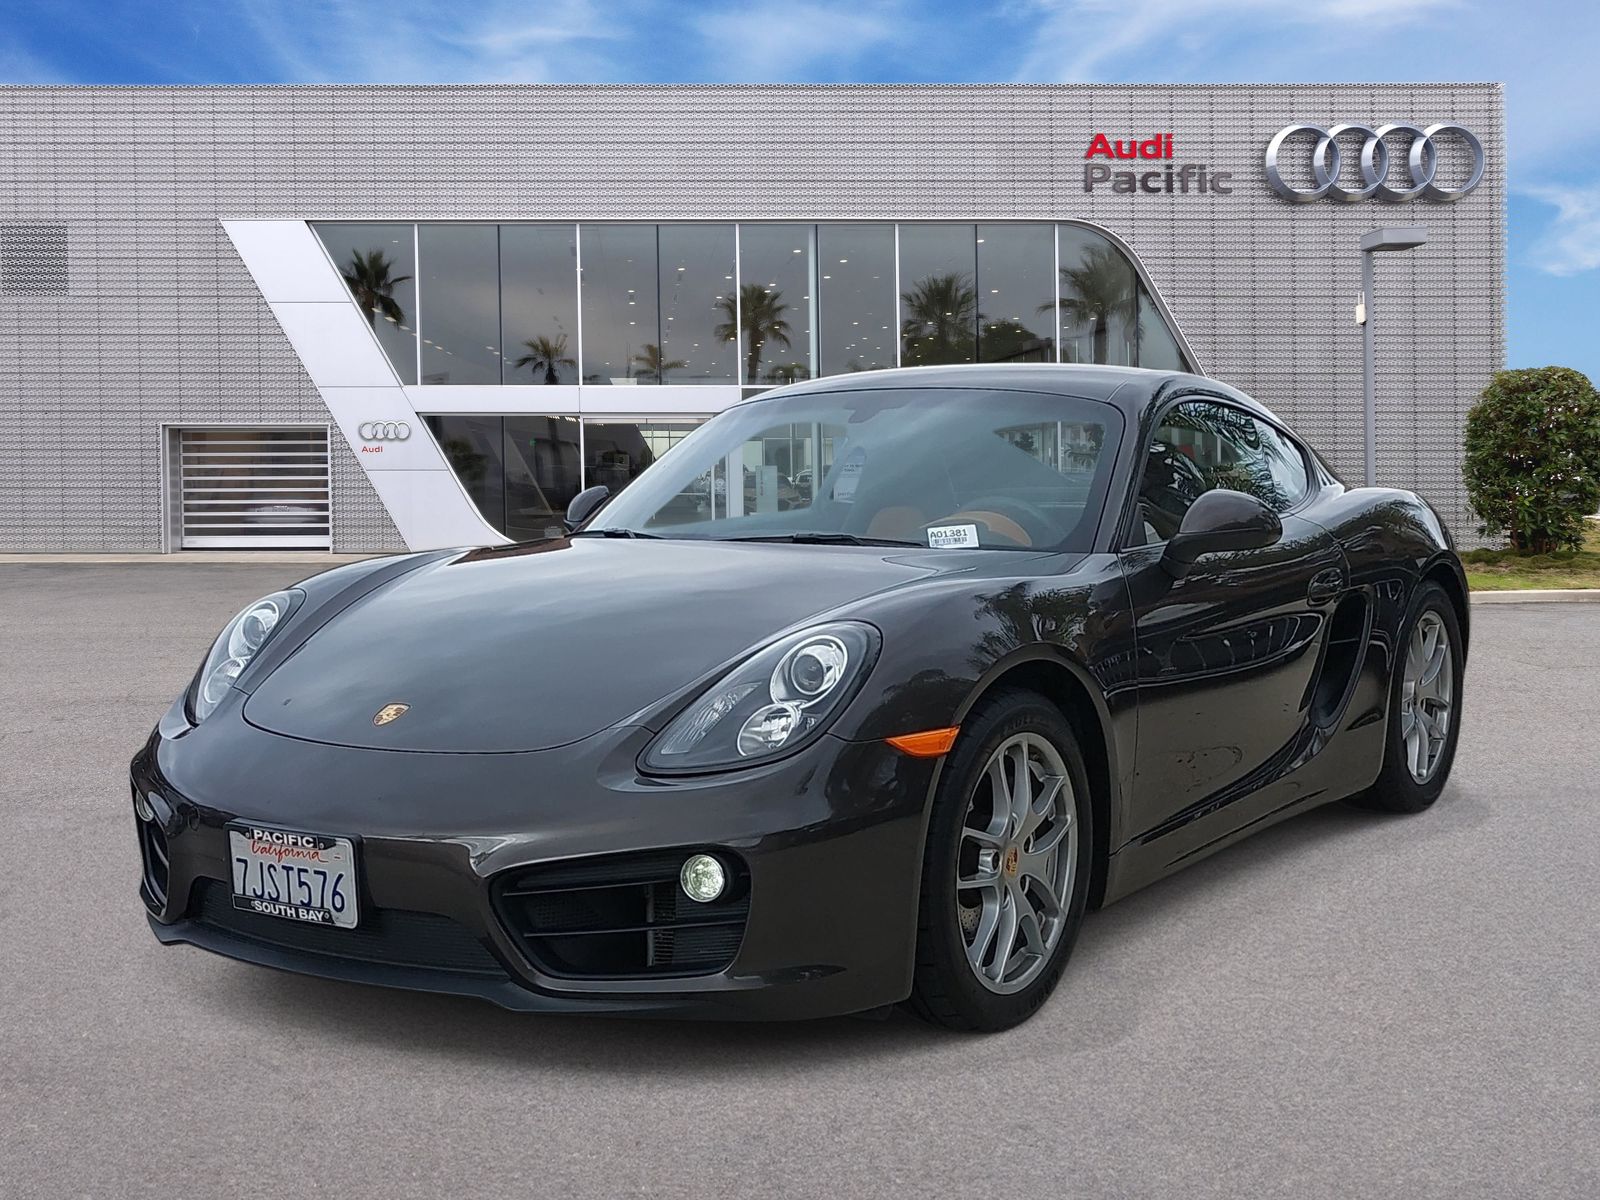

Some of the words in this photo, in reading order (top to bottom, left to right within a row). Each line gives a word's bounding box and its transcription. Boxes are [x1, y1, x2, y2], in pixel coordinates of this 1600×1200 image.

[1084, 133, 1173, 159] Audi
[1084, 163, 1232, 193] Pacific
[930, 528, 968, 539] A01381
[253, 829, 314, 848] PACIFIC
[251, 840, 328, 863] California
[236, 857, 345, 913] 7JST576
[254, 900, 296, 918] SOUTH
[298, 908, 324, 922] BAY
